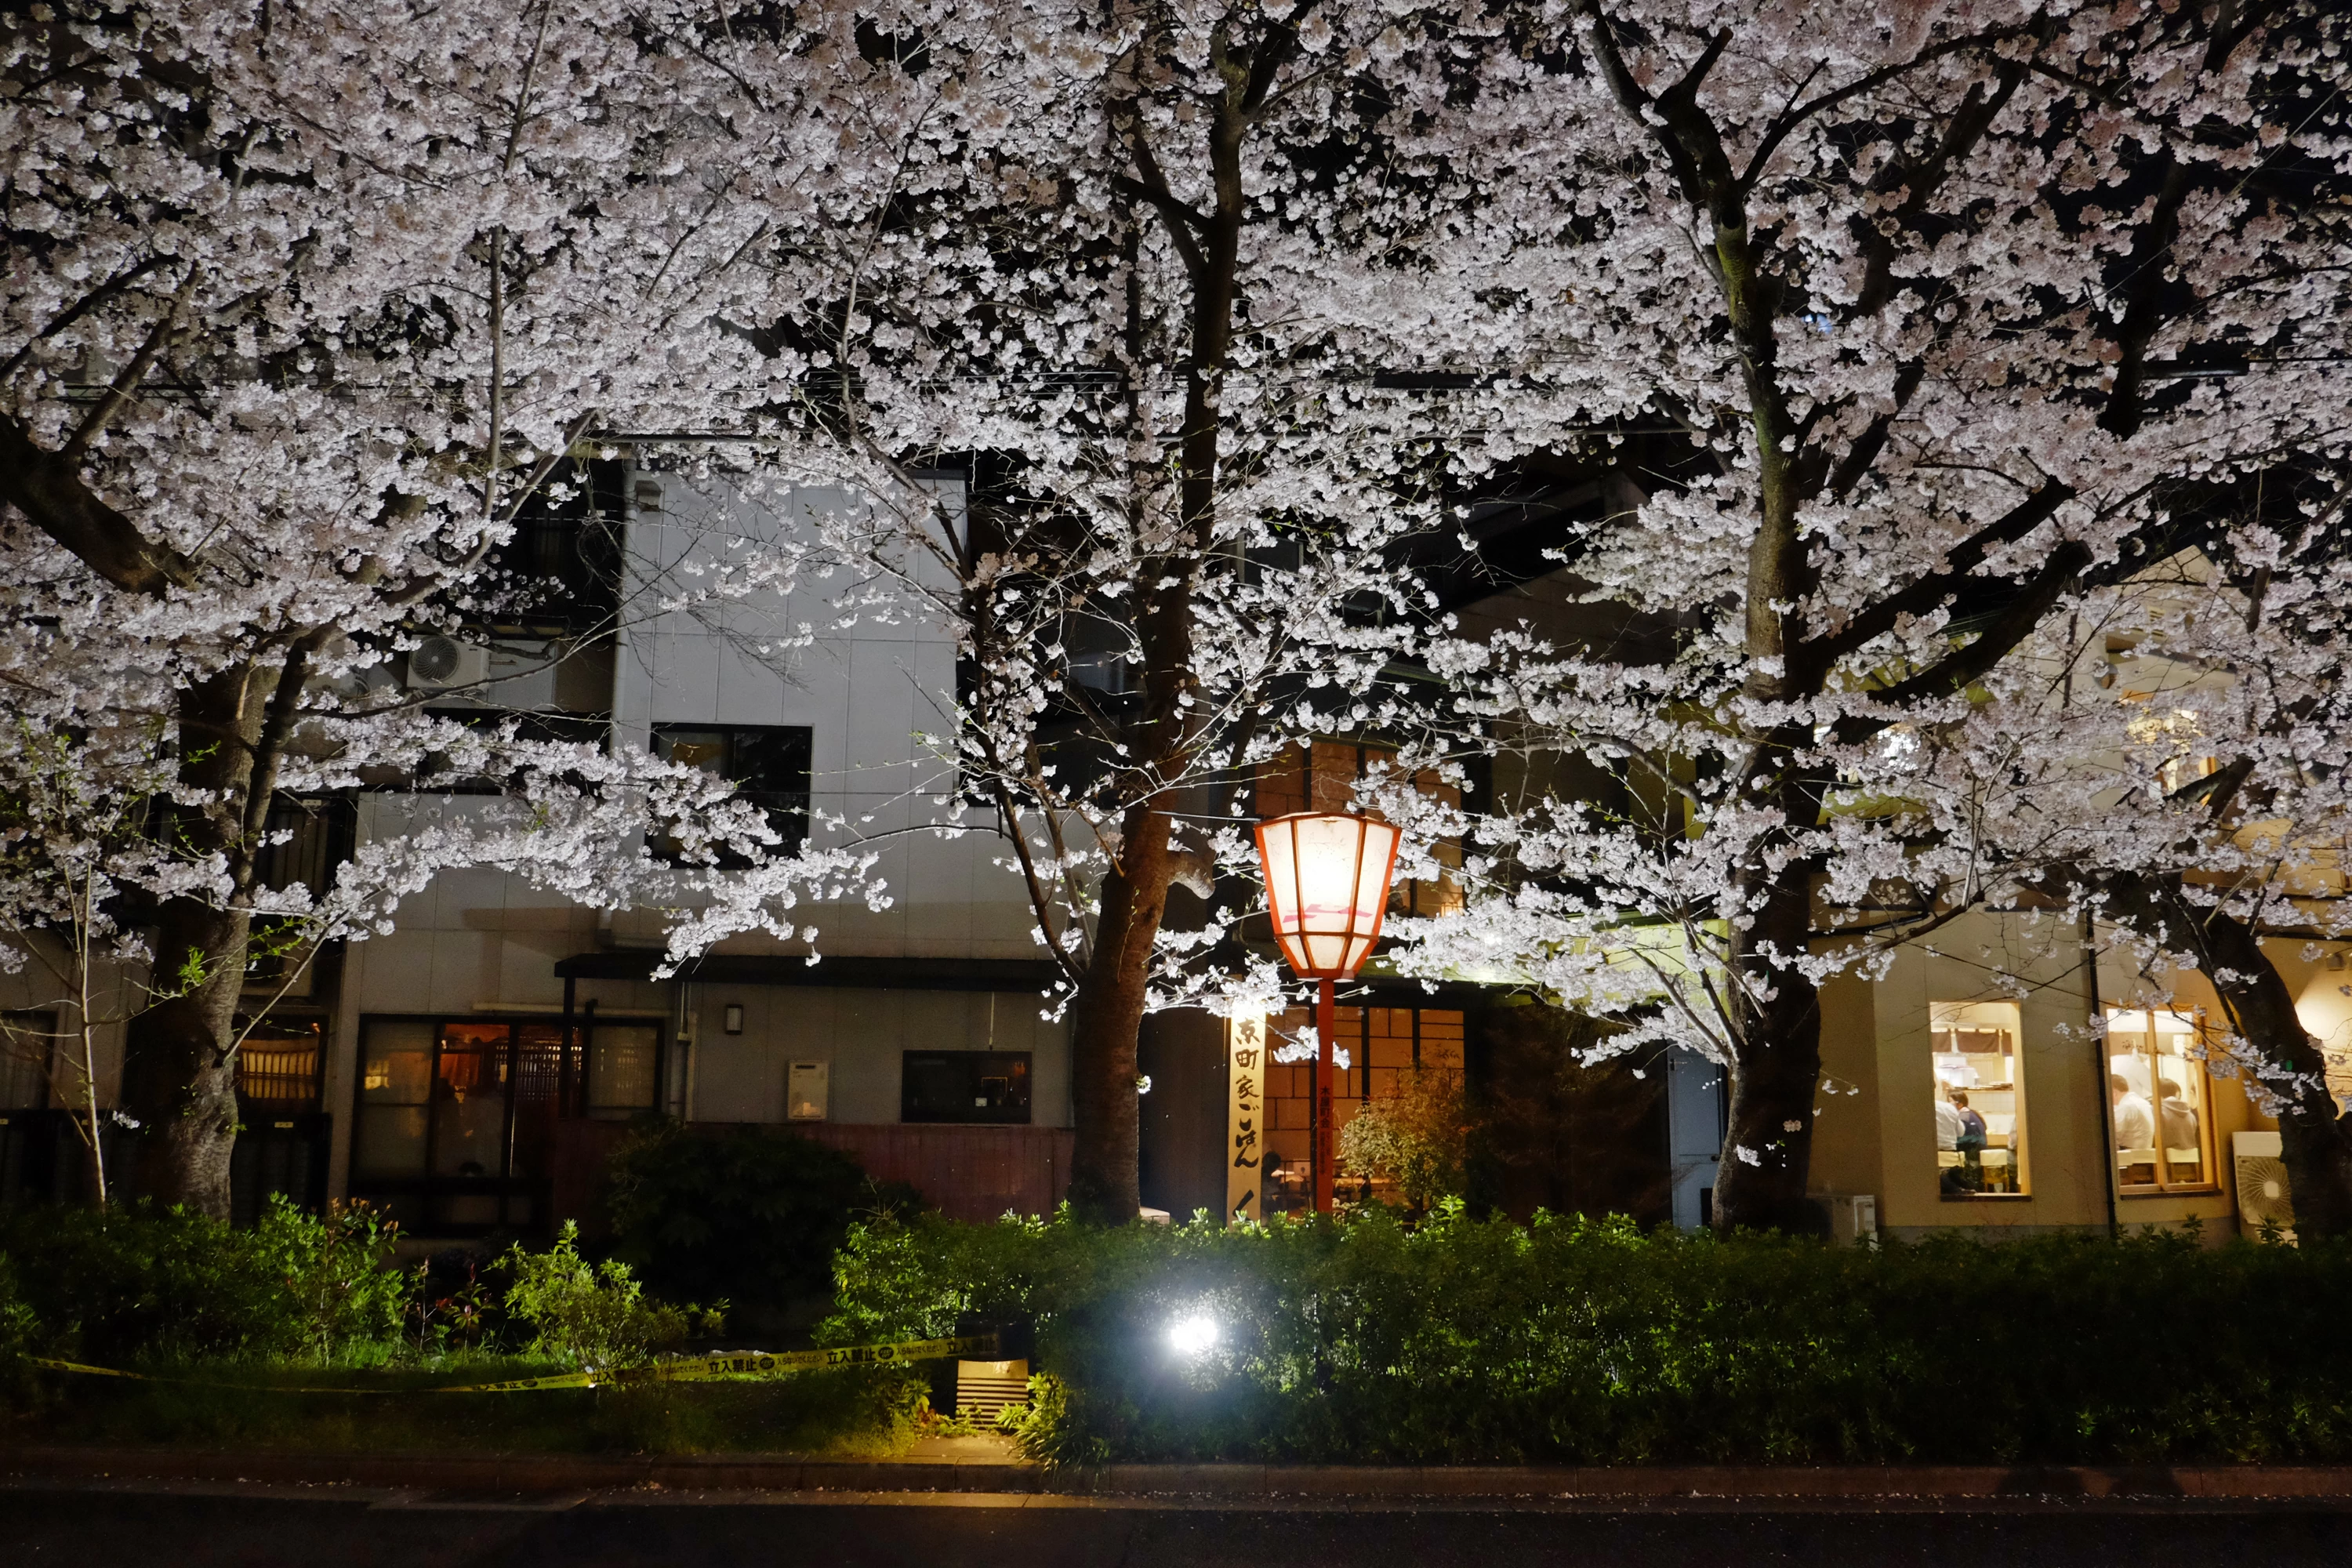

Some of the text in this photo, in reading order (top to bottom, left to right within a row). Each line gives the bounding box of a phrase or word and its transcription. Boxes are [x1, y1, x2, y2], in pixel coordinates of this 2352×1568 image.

[1233, 1016, 1261, 1168] 京町家ごはん
[708, 1357, 757, 1374] 立入禁止
[777, 1356, 822, 1366] 入らないでください
[827, 1348, 876, 1364] 立入禁止
[896, 1345, 942, 1356] 入らないでください
